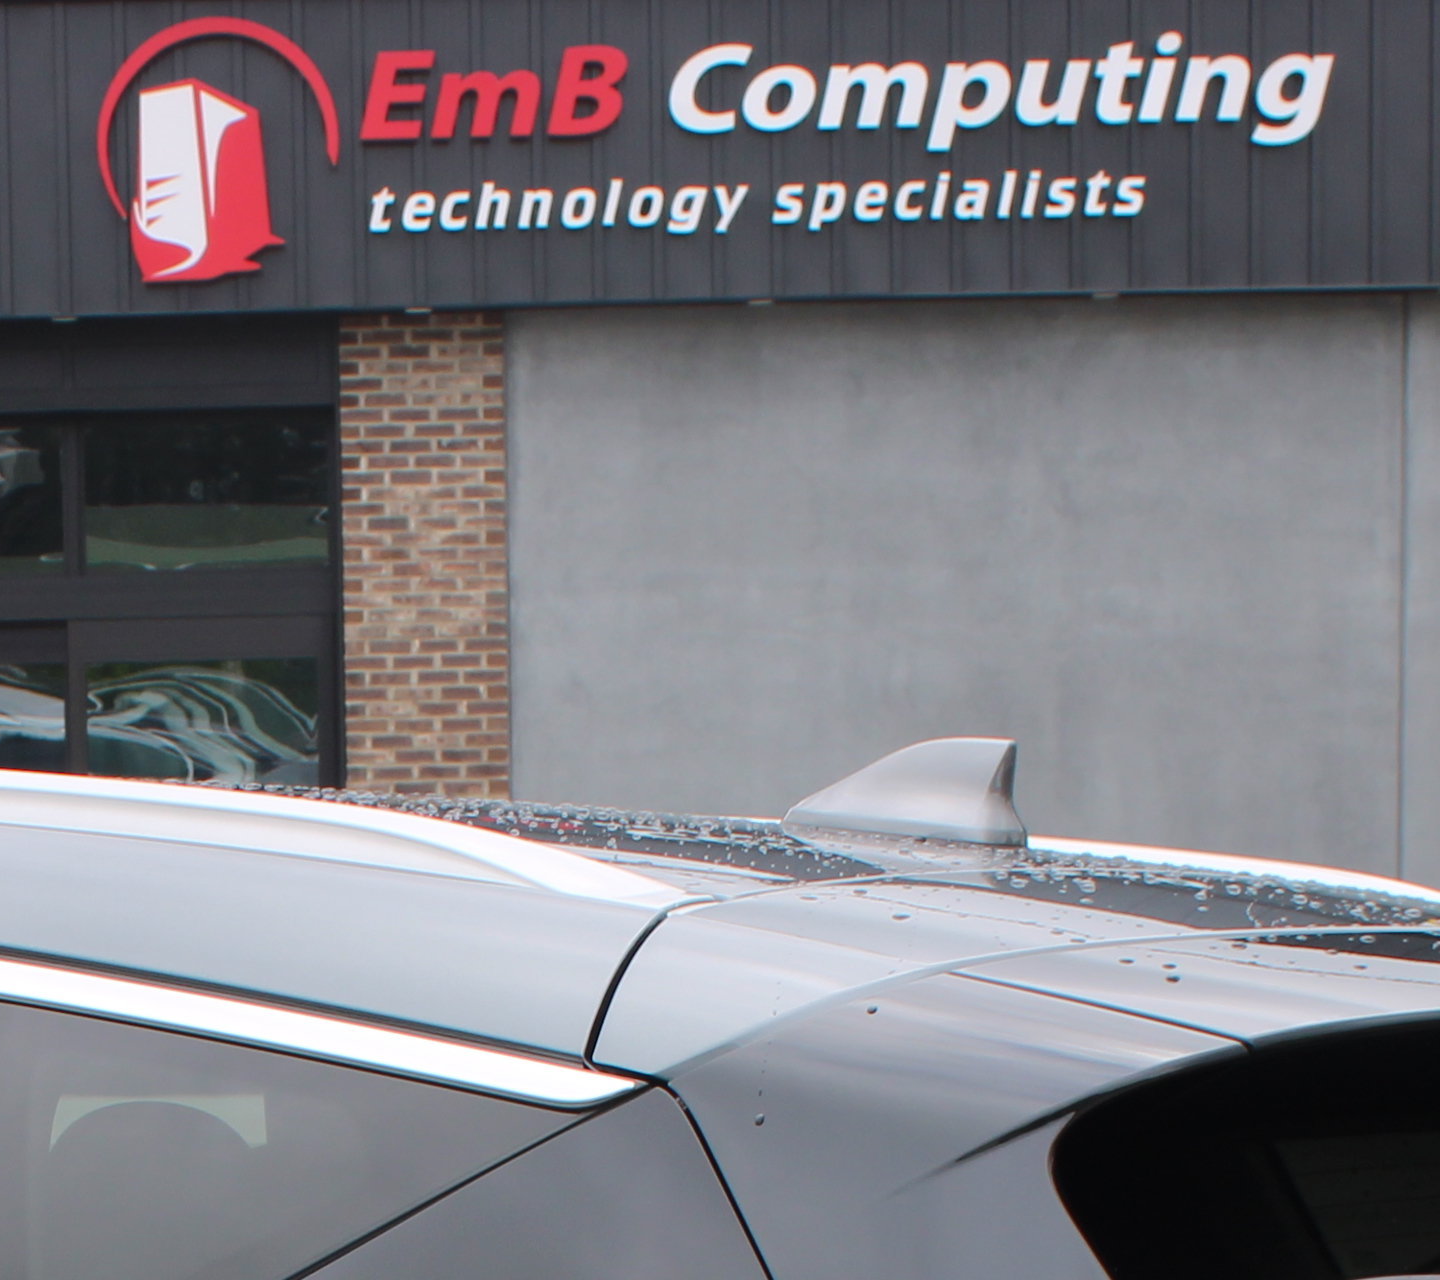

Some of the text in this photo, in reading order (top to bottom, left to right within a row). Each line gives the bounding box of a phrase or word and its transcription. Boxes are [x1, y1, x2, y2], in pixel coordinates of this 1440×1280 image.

[359, 31, 1333, 151] EmB Computing
[368, 167, 1148, 236] technology specialists
